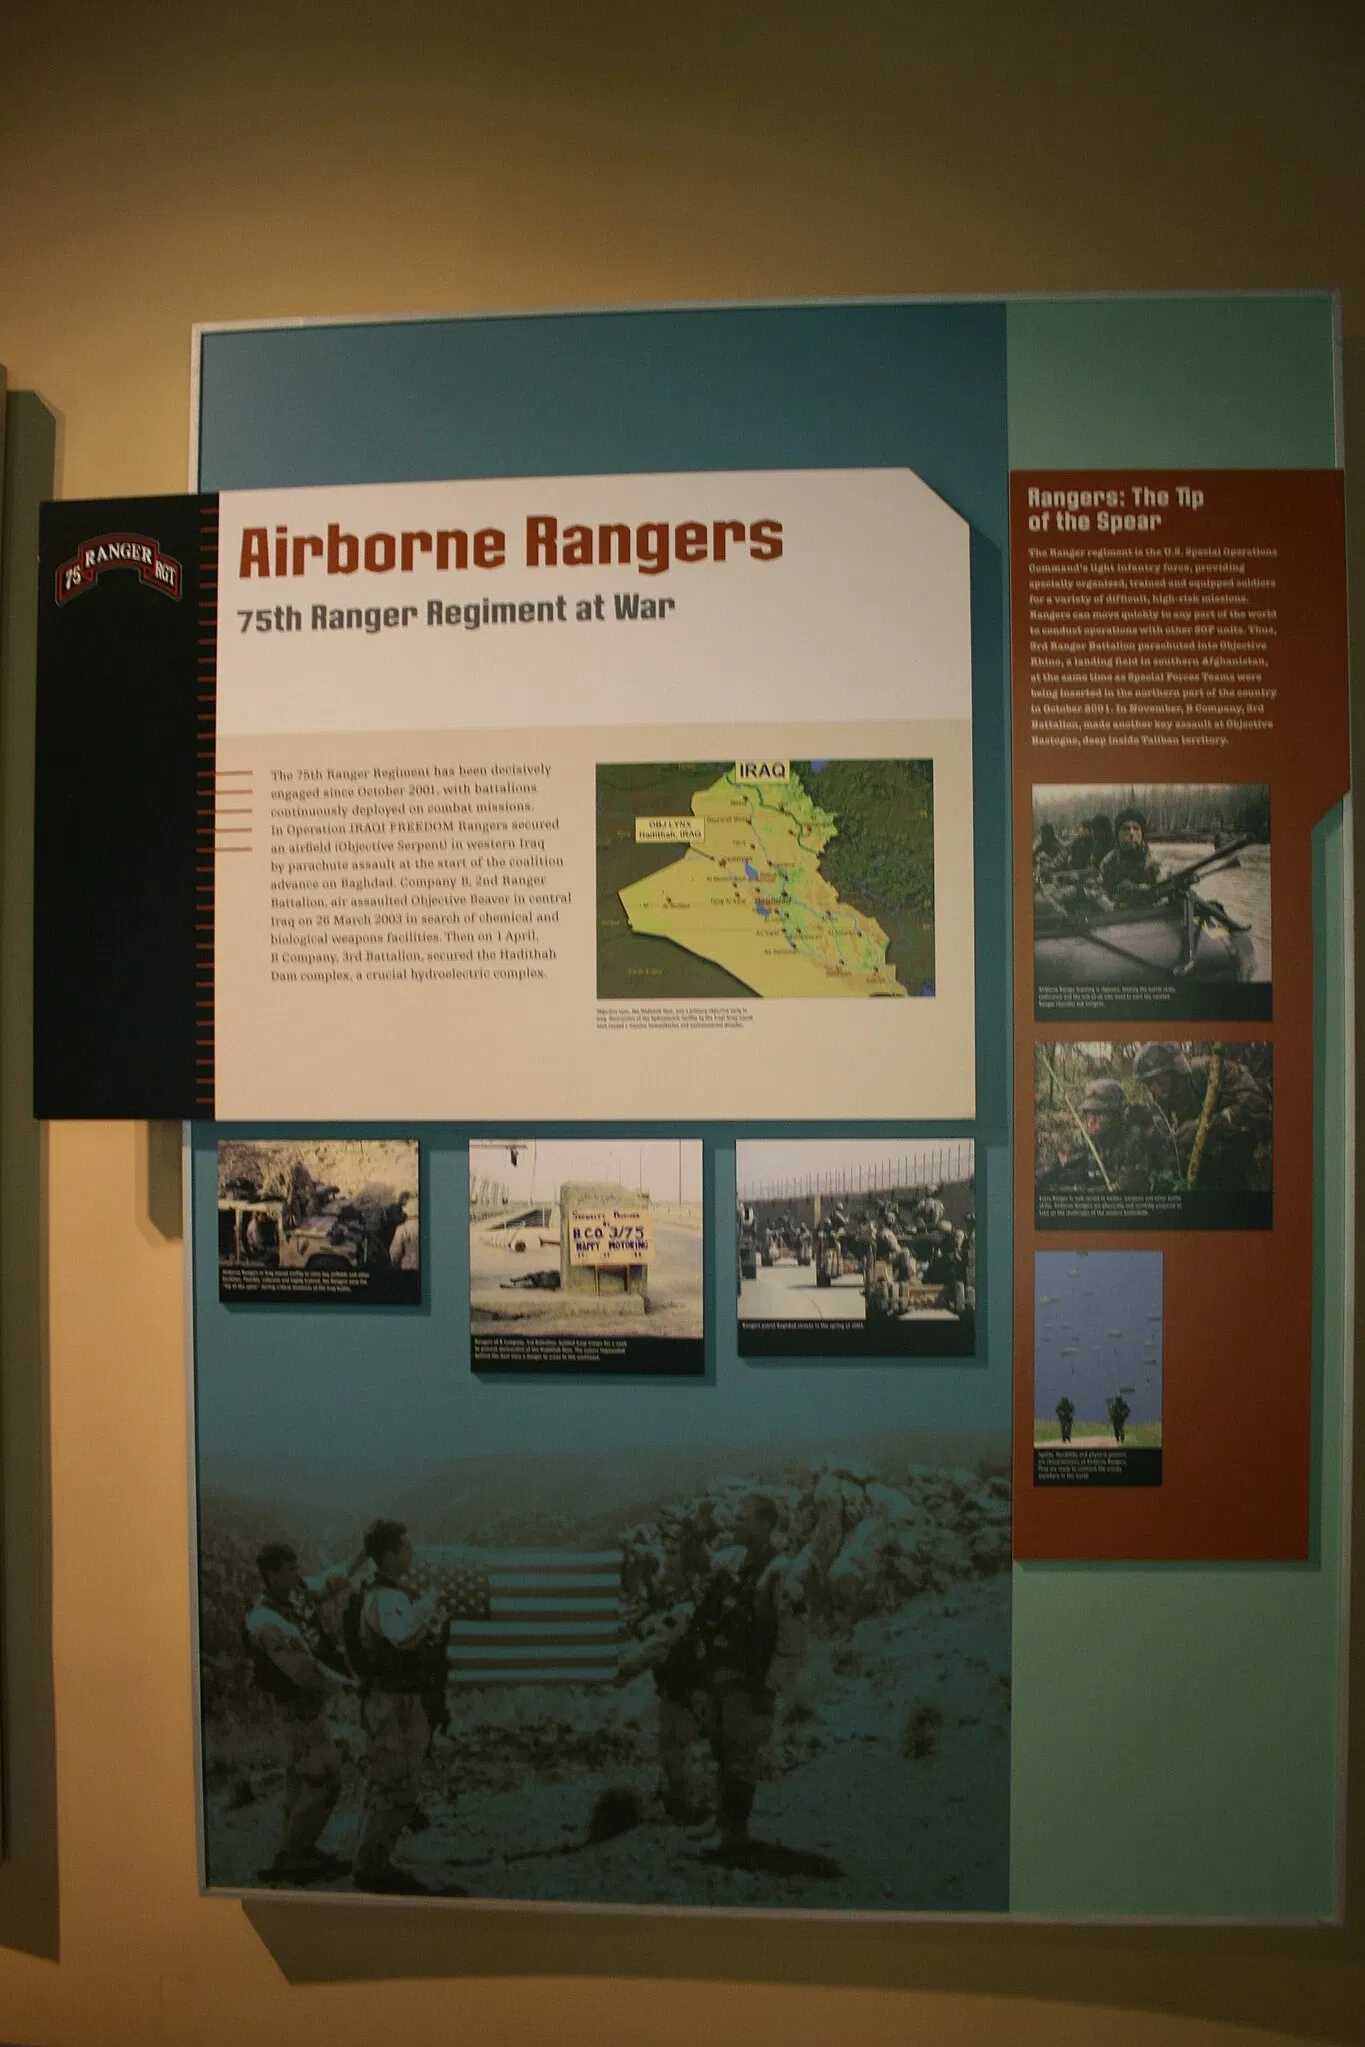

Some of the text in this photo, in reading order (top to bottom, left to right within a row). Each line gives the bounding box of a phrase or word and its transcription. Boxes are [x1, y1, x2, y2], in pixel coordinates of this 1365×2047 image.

[1029, 486, 1204, 511] Rangers: The Tip
[1029, 511, 1161, 535] of the Spear
[239, 515, 783, 578] Airborne Rangers
[65, 543, 176, 590] 75 RANGER RGT
[237, 593, 676, 634] 75th Ranger Regiment at War
[271, 762, 551, 781] The 75th Ranger Regiment has been decisively
[740, 763, 787, 779] IRAQ
[271, 780, 536, 801] engaged since October 2001, with battalions
[270, 799, 534, 819] continuously deployed on combat missions.
[271, 823, 283, 834] In
[286, 821, 346, 836] Operation
[390, 819, 454, 832] FREEDOM
[458, 818, 508, 833] Rangers
[512, 817, 559, 829] secured
[271, 844, 285, 853] an
[288, 840, 331, 852] airfield
[451, 837, 463, 849] in
[466, 836, 515, 849] western
[520, 836, 544, 850] Iraq
[270, 853, 564, 874] by parachute assault at the start of the coalition
[270, 877, 318, 889] advance
[322, 880, 336, 888] on
[341, 876, 396, 891] Baghdad.
[400, 874, 456, 889] Company
[476, 873, 498, 885] 2nd
[502, 873, 544, 887] Ranger
[271, 891, 571, 909] Battalion, air assaulted Objective Beaver in central
[271, 909, 559, 928] Iraq on 26 March 2003 in search of chemical and
[270, 928, 539, 947] biological weapons facilities. Then on 1 April,
[271, 947, 556, 965] B Company, 3rd Battalion, secured the Hadithah
[271, 966, 547, 983] Dam complex, a crucial hydroelectric complex.
